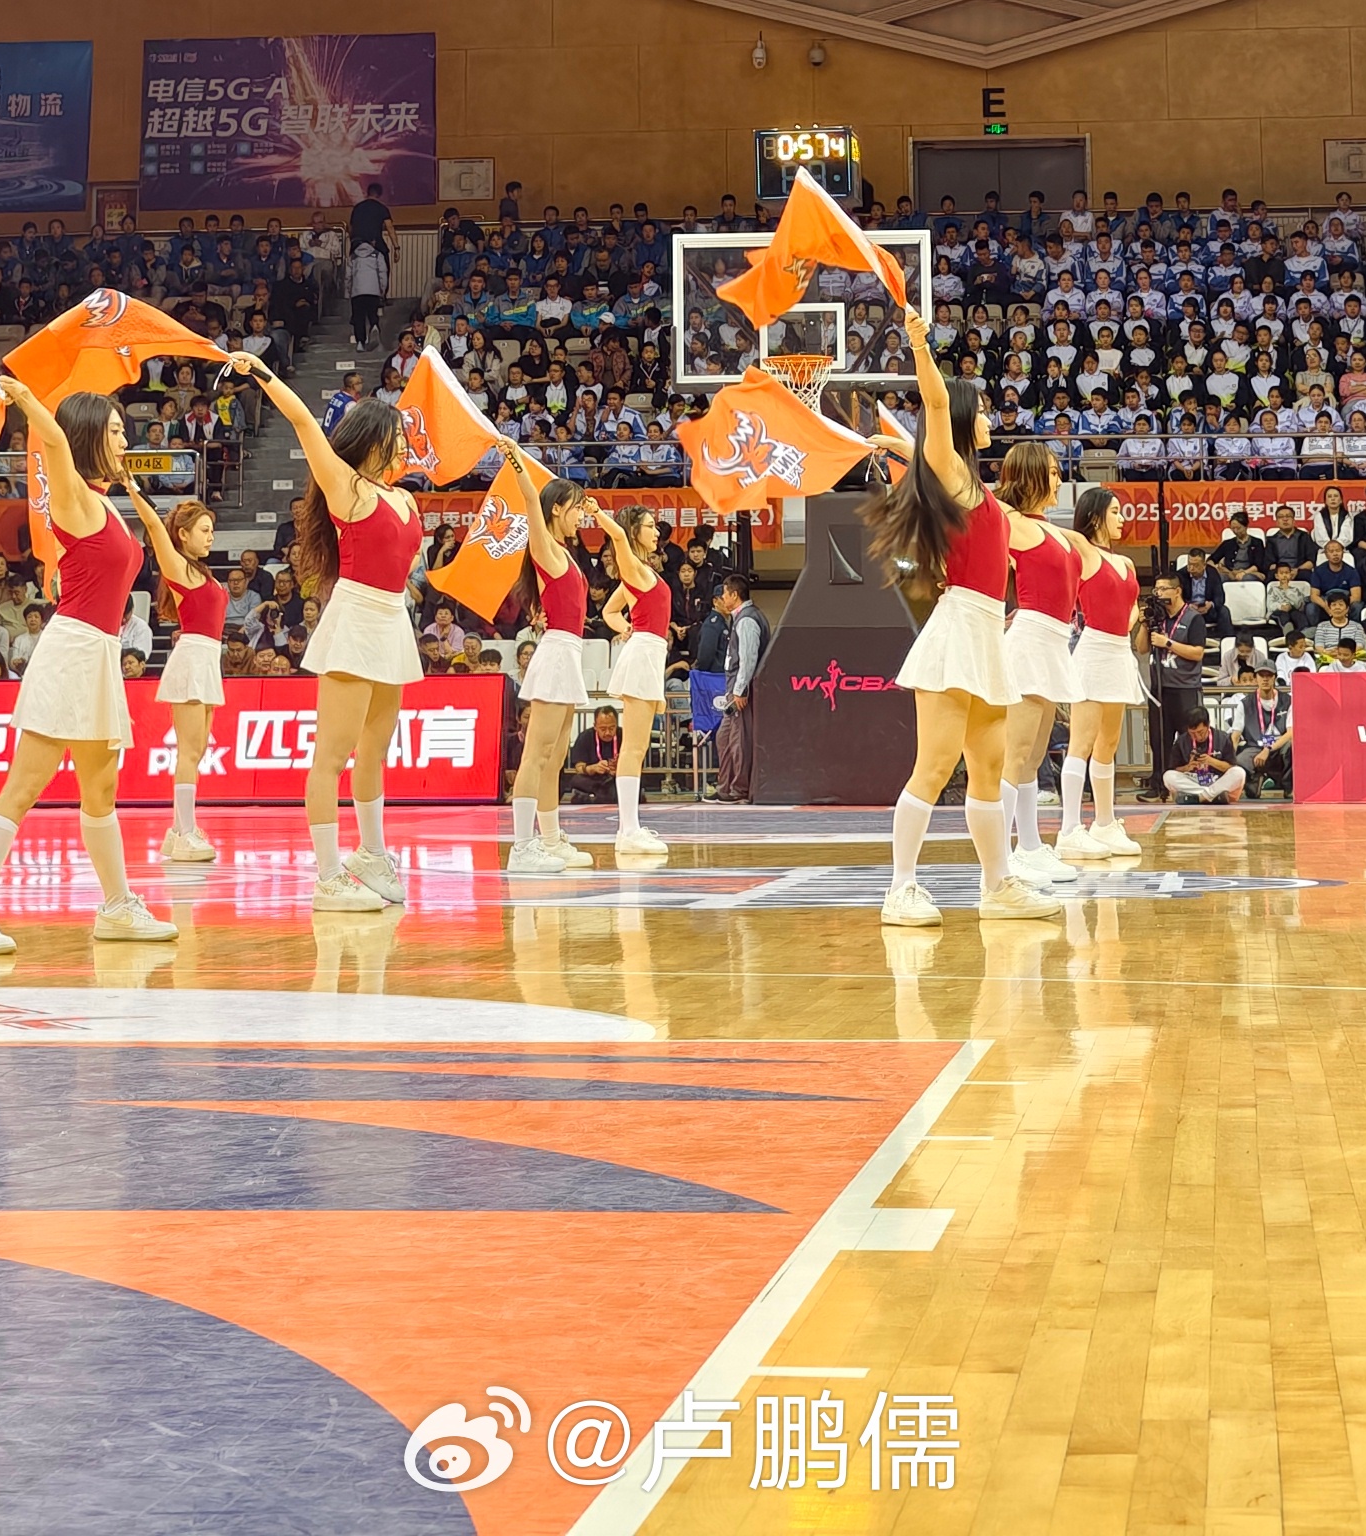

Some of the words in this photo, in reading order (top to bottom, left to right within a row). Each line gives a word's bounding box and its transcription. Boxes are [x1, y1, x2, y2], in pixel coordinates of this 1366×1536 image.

[146, 77, 290, 103] 电信5G-A
[981, 87, 1007, 118] E
[144, 106, 270, 139] 超越5G
[279, 101, 421, 135] 智联未来
[127, 457, 164, 470] 104区
